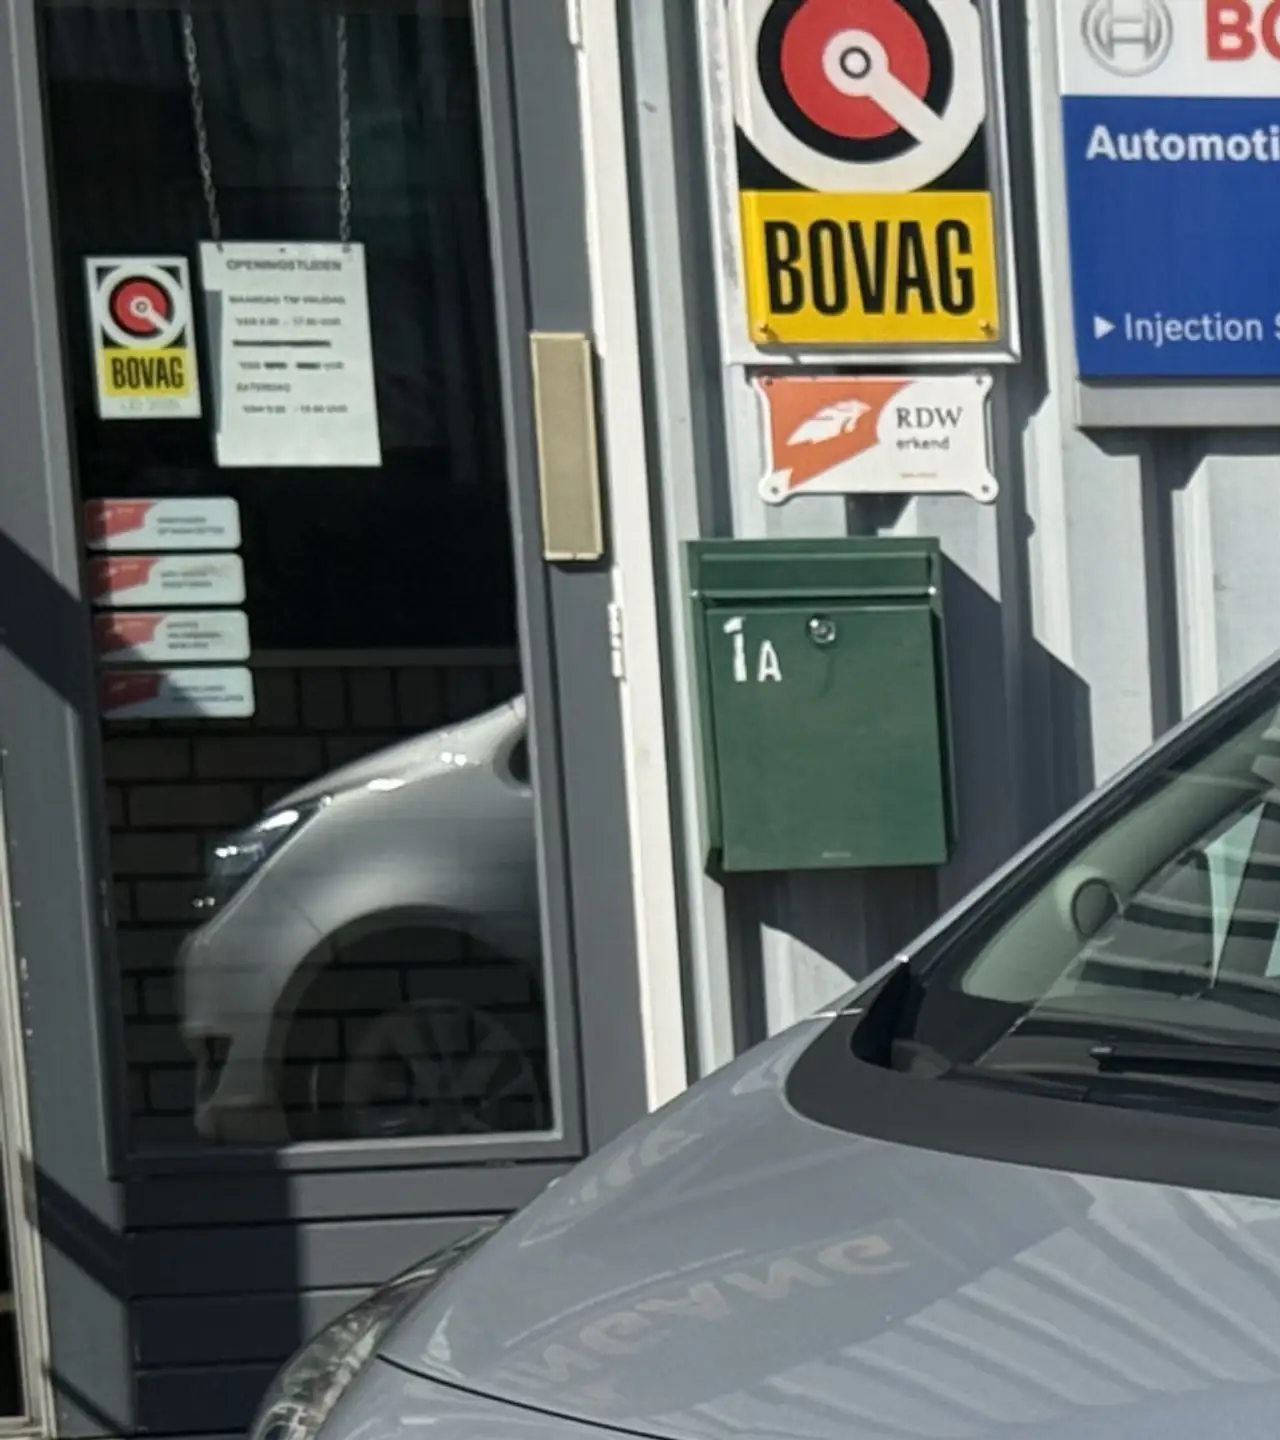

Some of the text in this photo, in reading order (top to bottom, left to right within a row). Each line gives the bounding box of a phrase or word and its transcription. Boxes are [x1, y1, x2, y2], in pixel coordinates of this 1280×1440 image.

[763, 219, 975, 316] BOVAG
[1125, 312, 1263, 348] Injection
[111, 356, 184, 389] BOVAG
[896, 406, 963, 428] RDW
[896, 436, 950, 450] erkend
